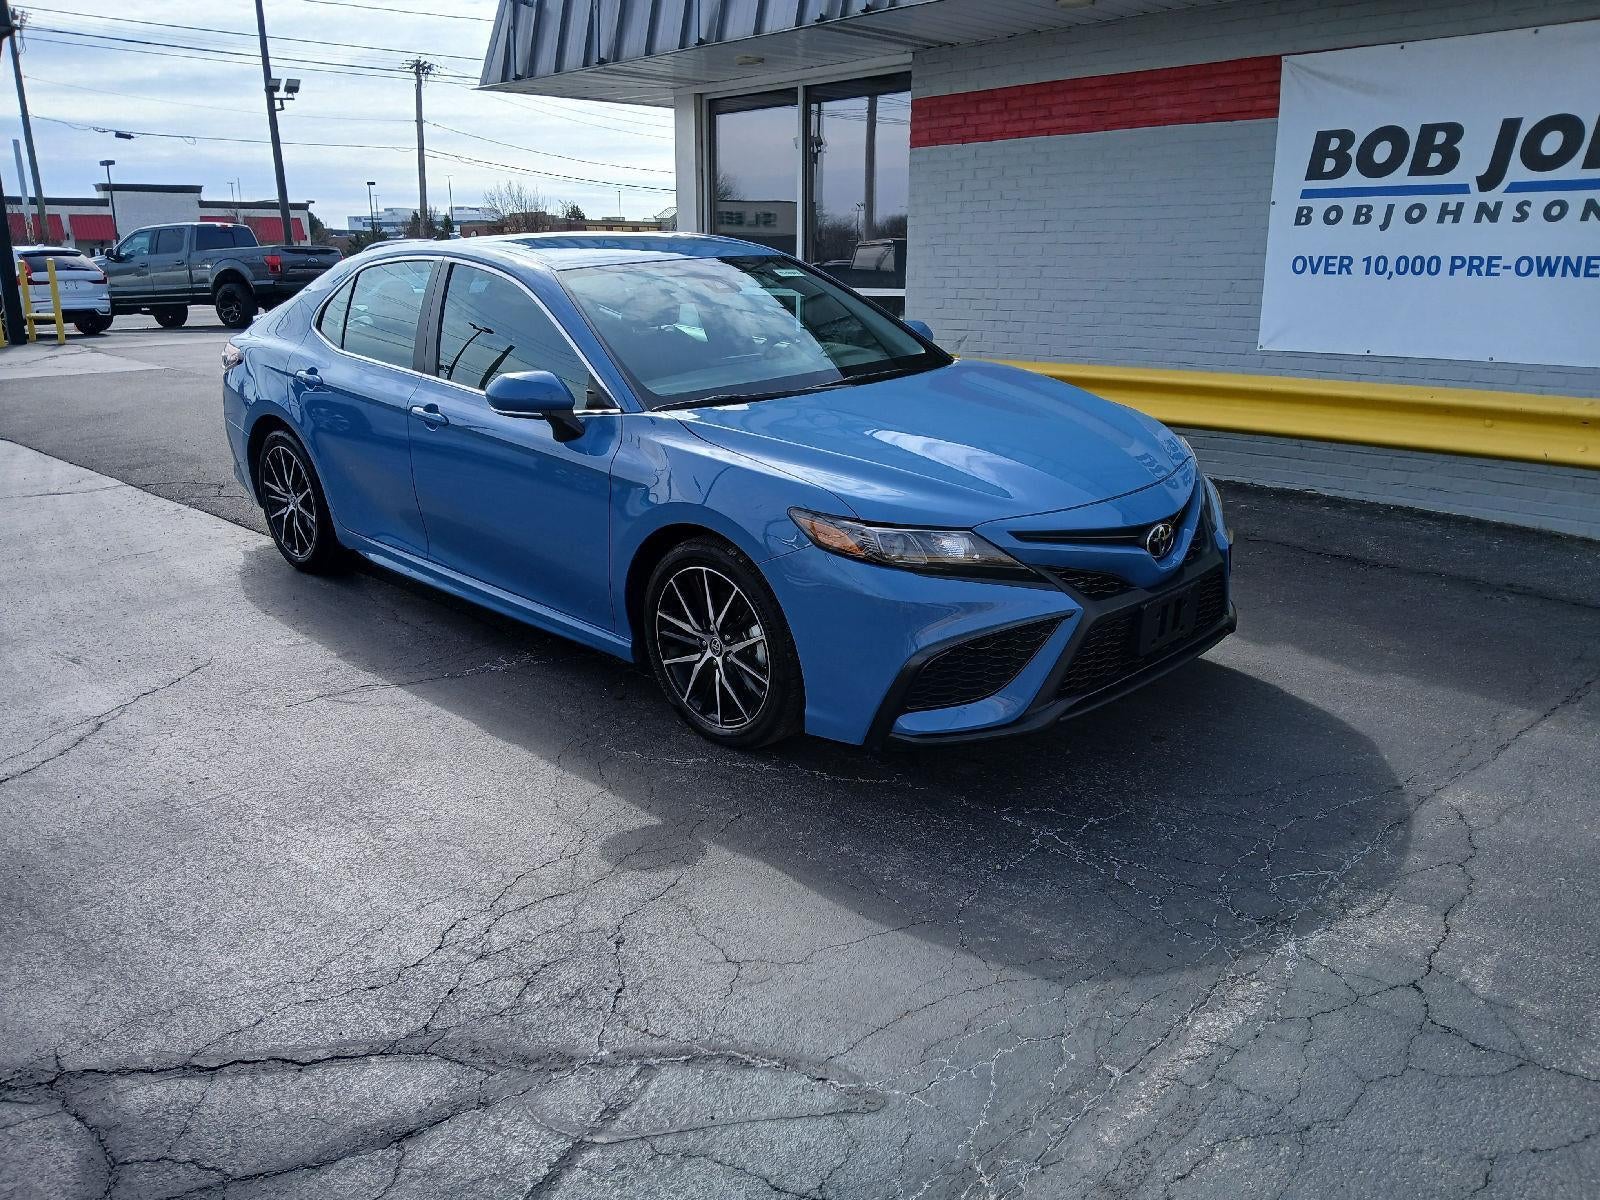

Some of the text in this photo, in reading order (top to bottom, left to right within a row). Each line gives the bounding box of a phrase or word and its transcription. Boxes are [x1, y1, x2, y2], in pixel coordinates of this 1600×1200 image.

[1304, 121, 1465, 182] BOB
[1291, 254, 1600, 280] OVER 10,000 PRE-OWNE
